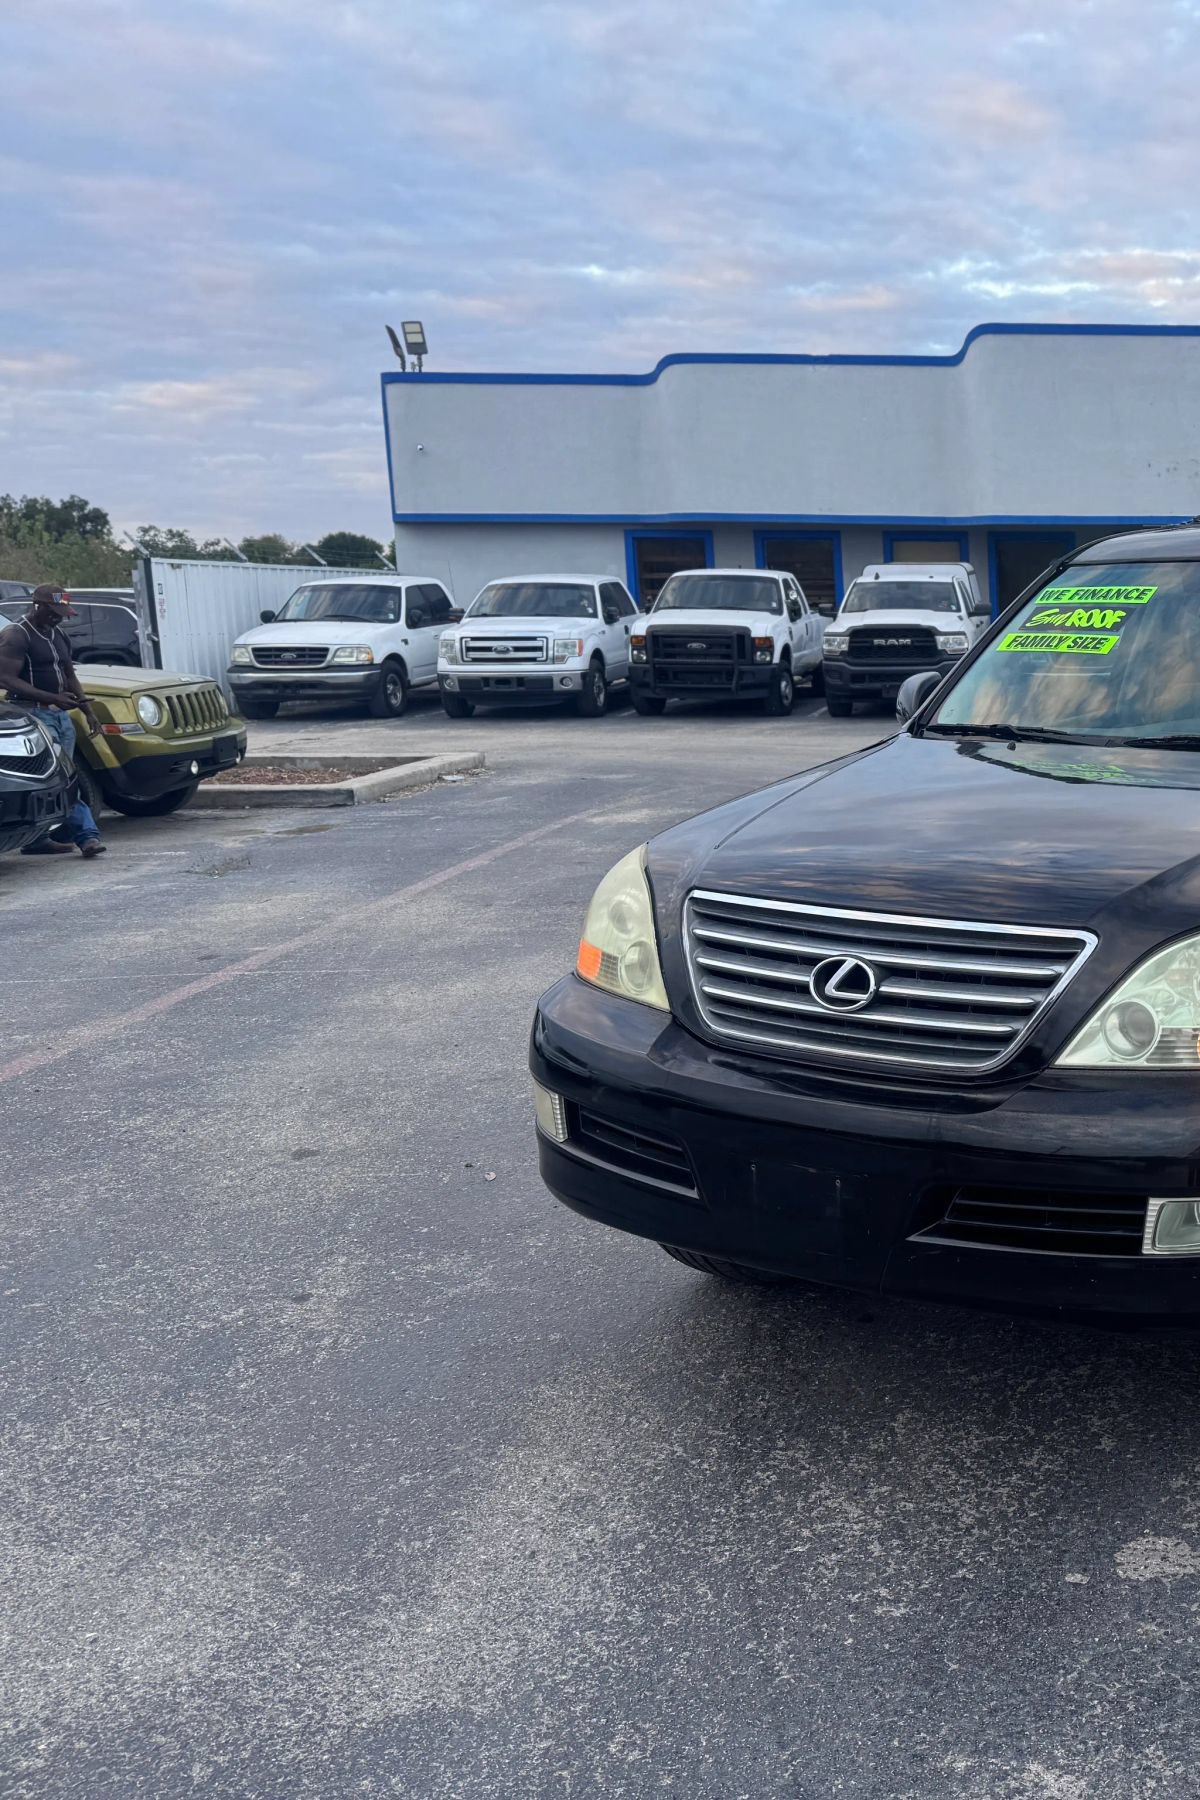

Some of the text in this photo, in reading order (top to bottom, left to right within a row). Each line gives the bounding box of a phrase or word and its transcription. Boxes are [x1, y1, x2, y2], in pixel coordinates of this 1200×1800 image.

[1040, 587, 1152, 601] WE FINANCE
[1006, 635, 1109, 650] FAMILY SIZE
